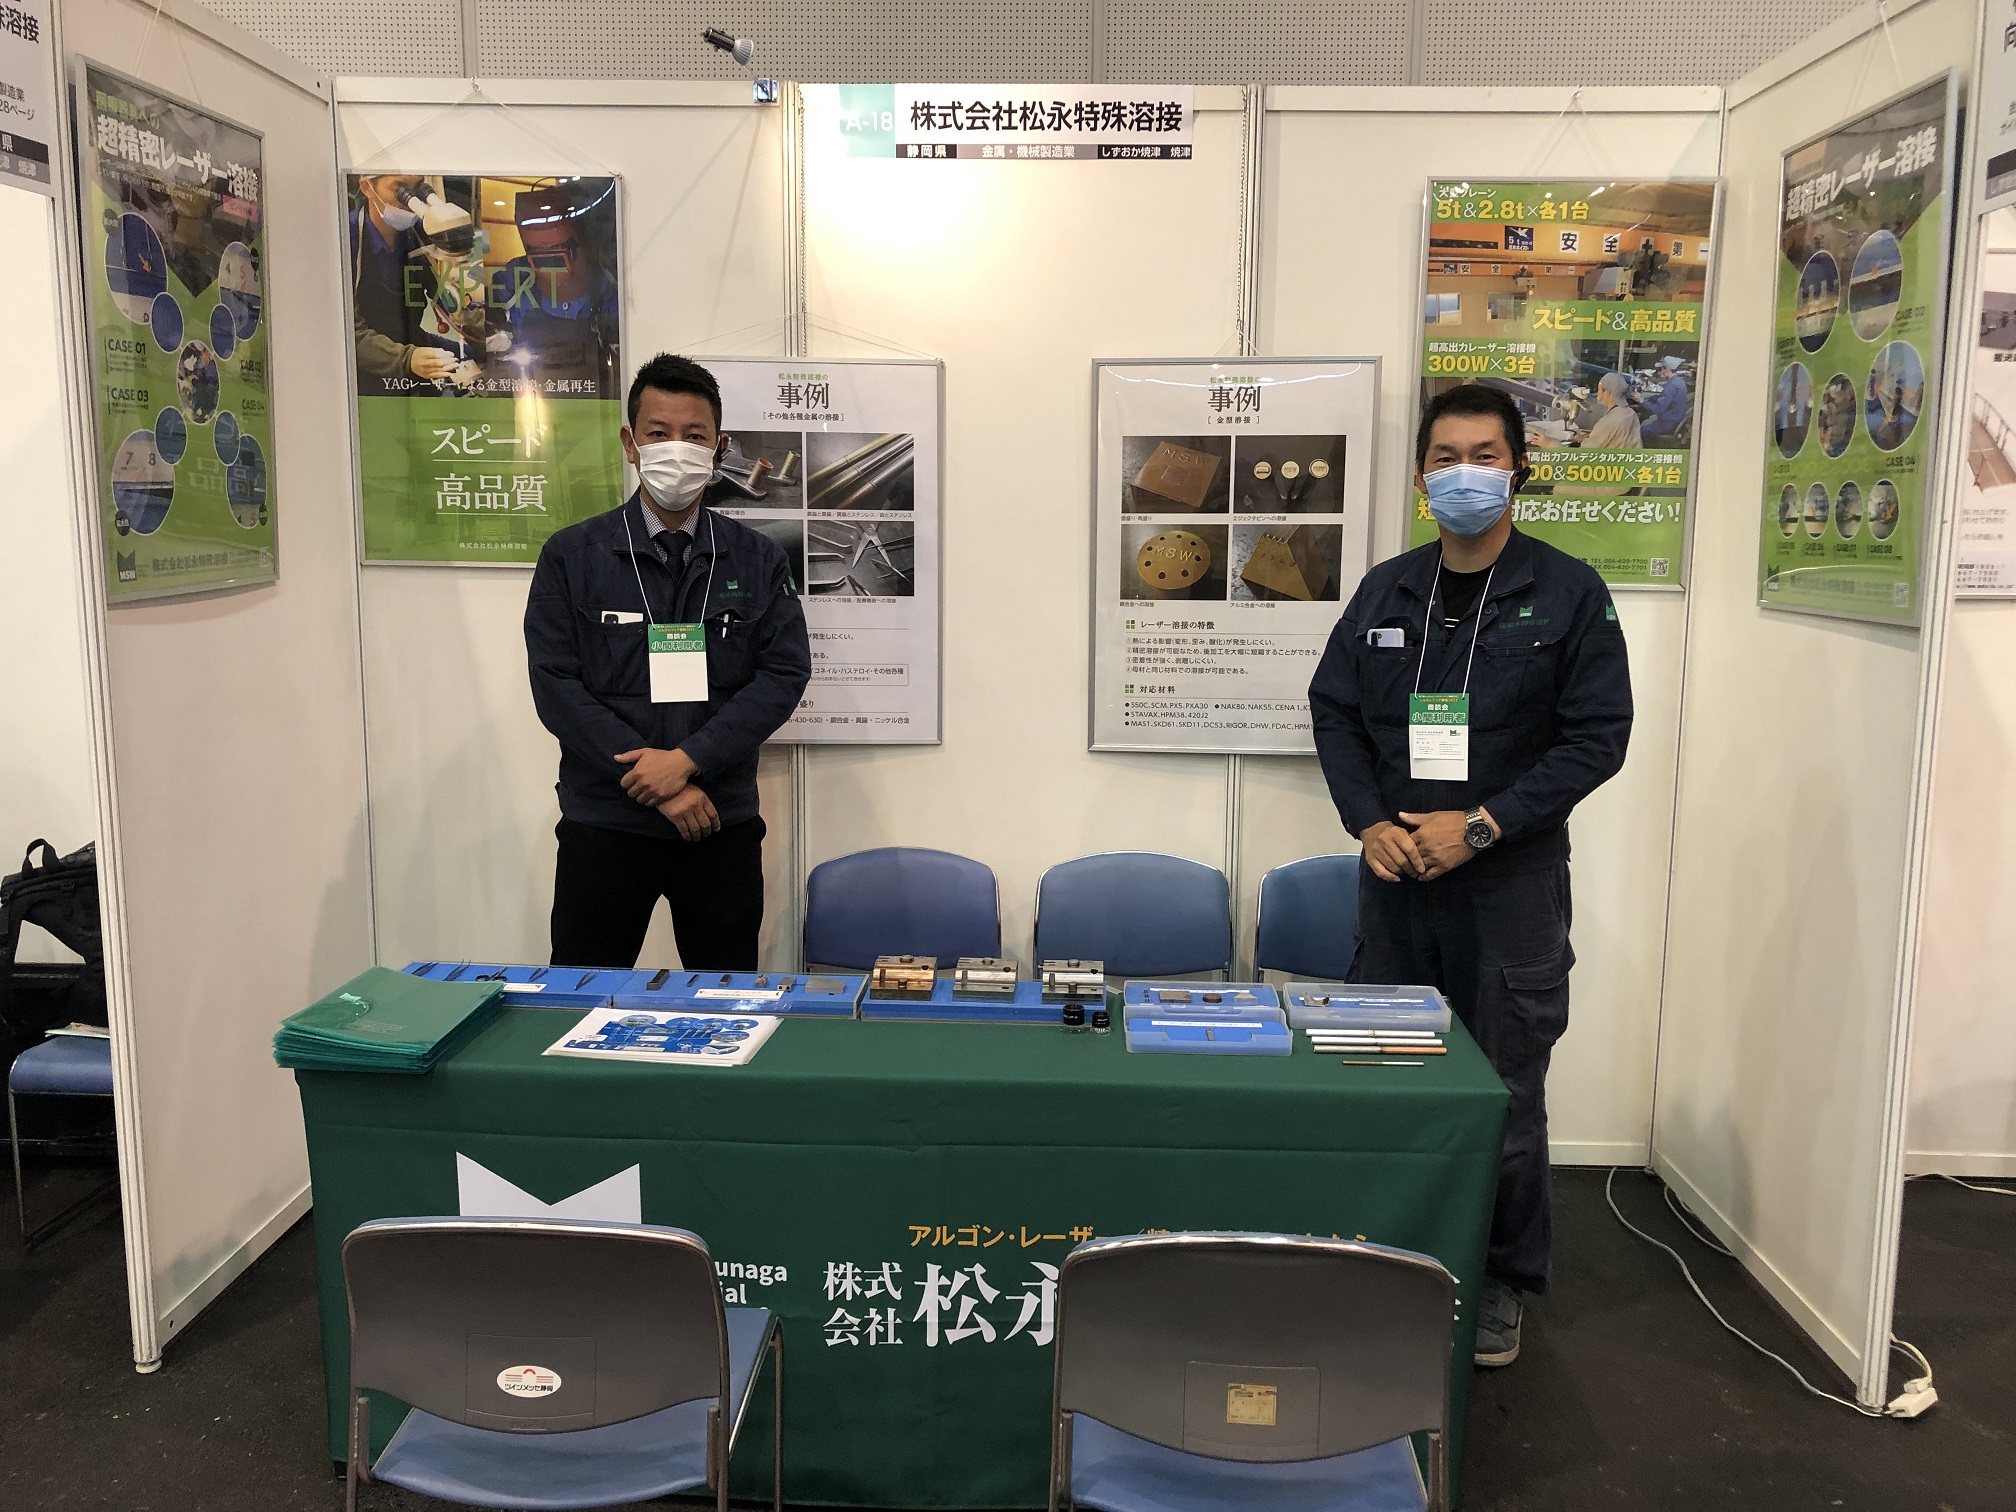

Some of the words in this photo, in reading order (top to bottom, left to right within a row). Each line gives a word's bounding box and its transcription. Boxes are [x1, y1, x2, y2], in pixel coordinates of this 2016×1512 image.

[0, 4, 40, 45] 溶接
[845, 111, 894, 132] A-18
[910, 101, 1183, 132] 株式会社松永特殊溶接
[97, 114, 258, 201] 超精密レーザー溶接
[907, 145, 947, 158] 静岡県
[981, 145, 1075, 158] 金属・機械製造業
[1101, 147, 1162, 158] しずおか焼津
[1170, 147, 1192, 158] 焼津
[1786, 125, 1938, 222] 超精密レーザー溶接
[403, 265, 568, 310] EXPERT
[1532, 308, 1697, 333] スピード&高品質
[108, 338, 133, 353] CASE
[1428, 341, 1537, 354] 超高出力レーザー溶接機
[1427, 355, 1536, 375] 300W×3台
[111, 387, 136, 402] CASE
[776, 382, 830, 410] 事例
[1207, 386, 1261, 413] 事例
[431, 423, 548, 459] スピード
[433, 473, 549, 512] 高品質
[1139, 684, 1176, 694] 対応材料
[1411, 712, 1467, 724] 小間利用者
[822, 1261, 903, 1301] 株式
[822, 1307, 903, 1347] 会社
